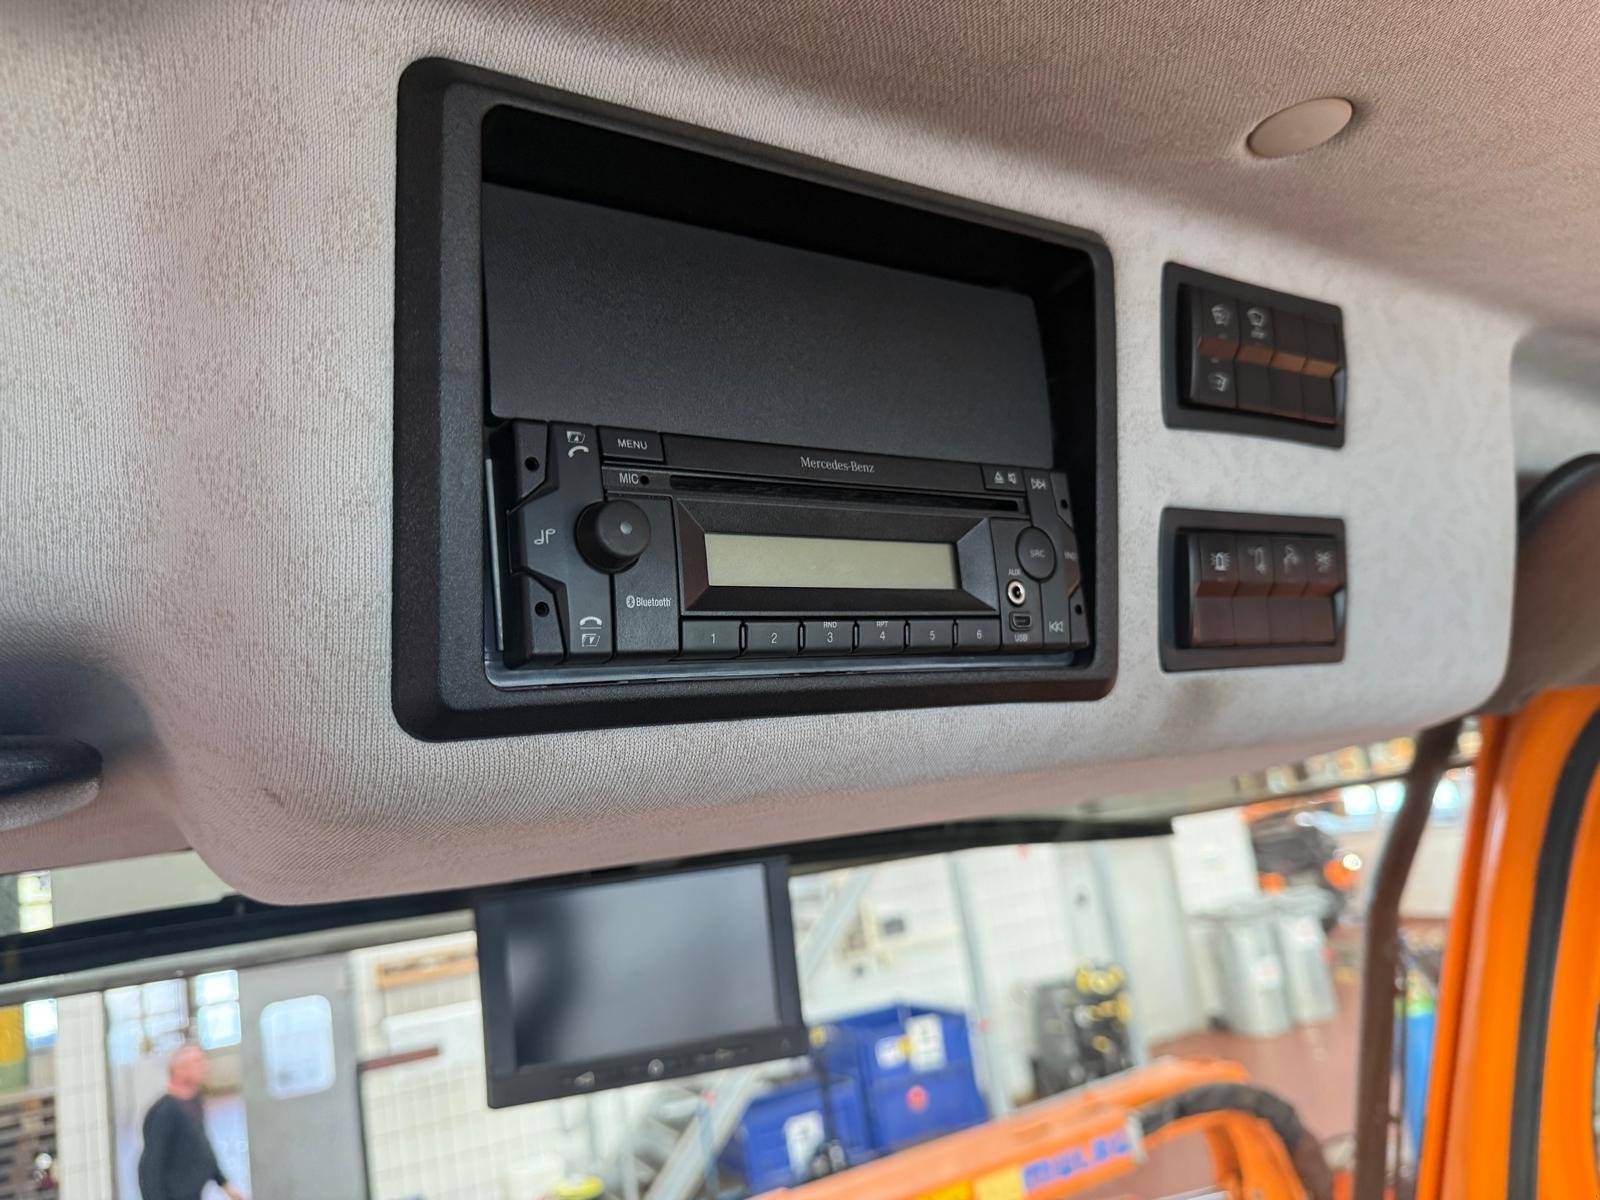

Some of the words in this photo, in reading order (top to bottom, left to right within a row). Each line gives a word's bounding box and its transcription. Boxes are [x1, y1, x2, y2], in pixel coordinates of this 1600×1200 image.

[617, 438, 648, 450] MENU
[800, 456, 875, 474] Mercedes-Benz
[619, 473, 639, 485] MIC
[1008, 568, 1021, 577] AUX
[636, 597, 671, 608] Bluetooth
[711, 633, 716, 644] 1
[770, 633, 777, 643] 2
[826, 632, 833, 643] 3
[879, 630, 886, 641] 4
[929, 630, 936, 640] 5
[976, 630, 982, 640] 6
[1014, 633, 1028, 643] USB
